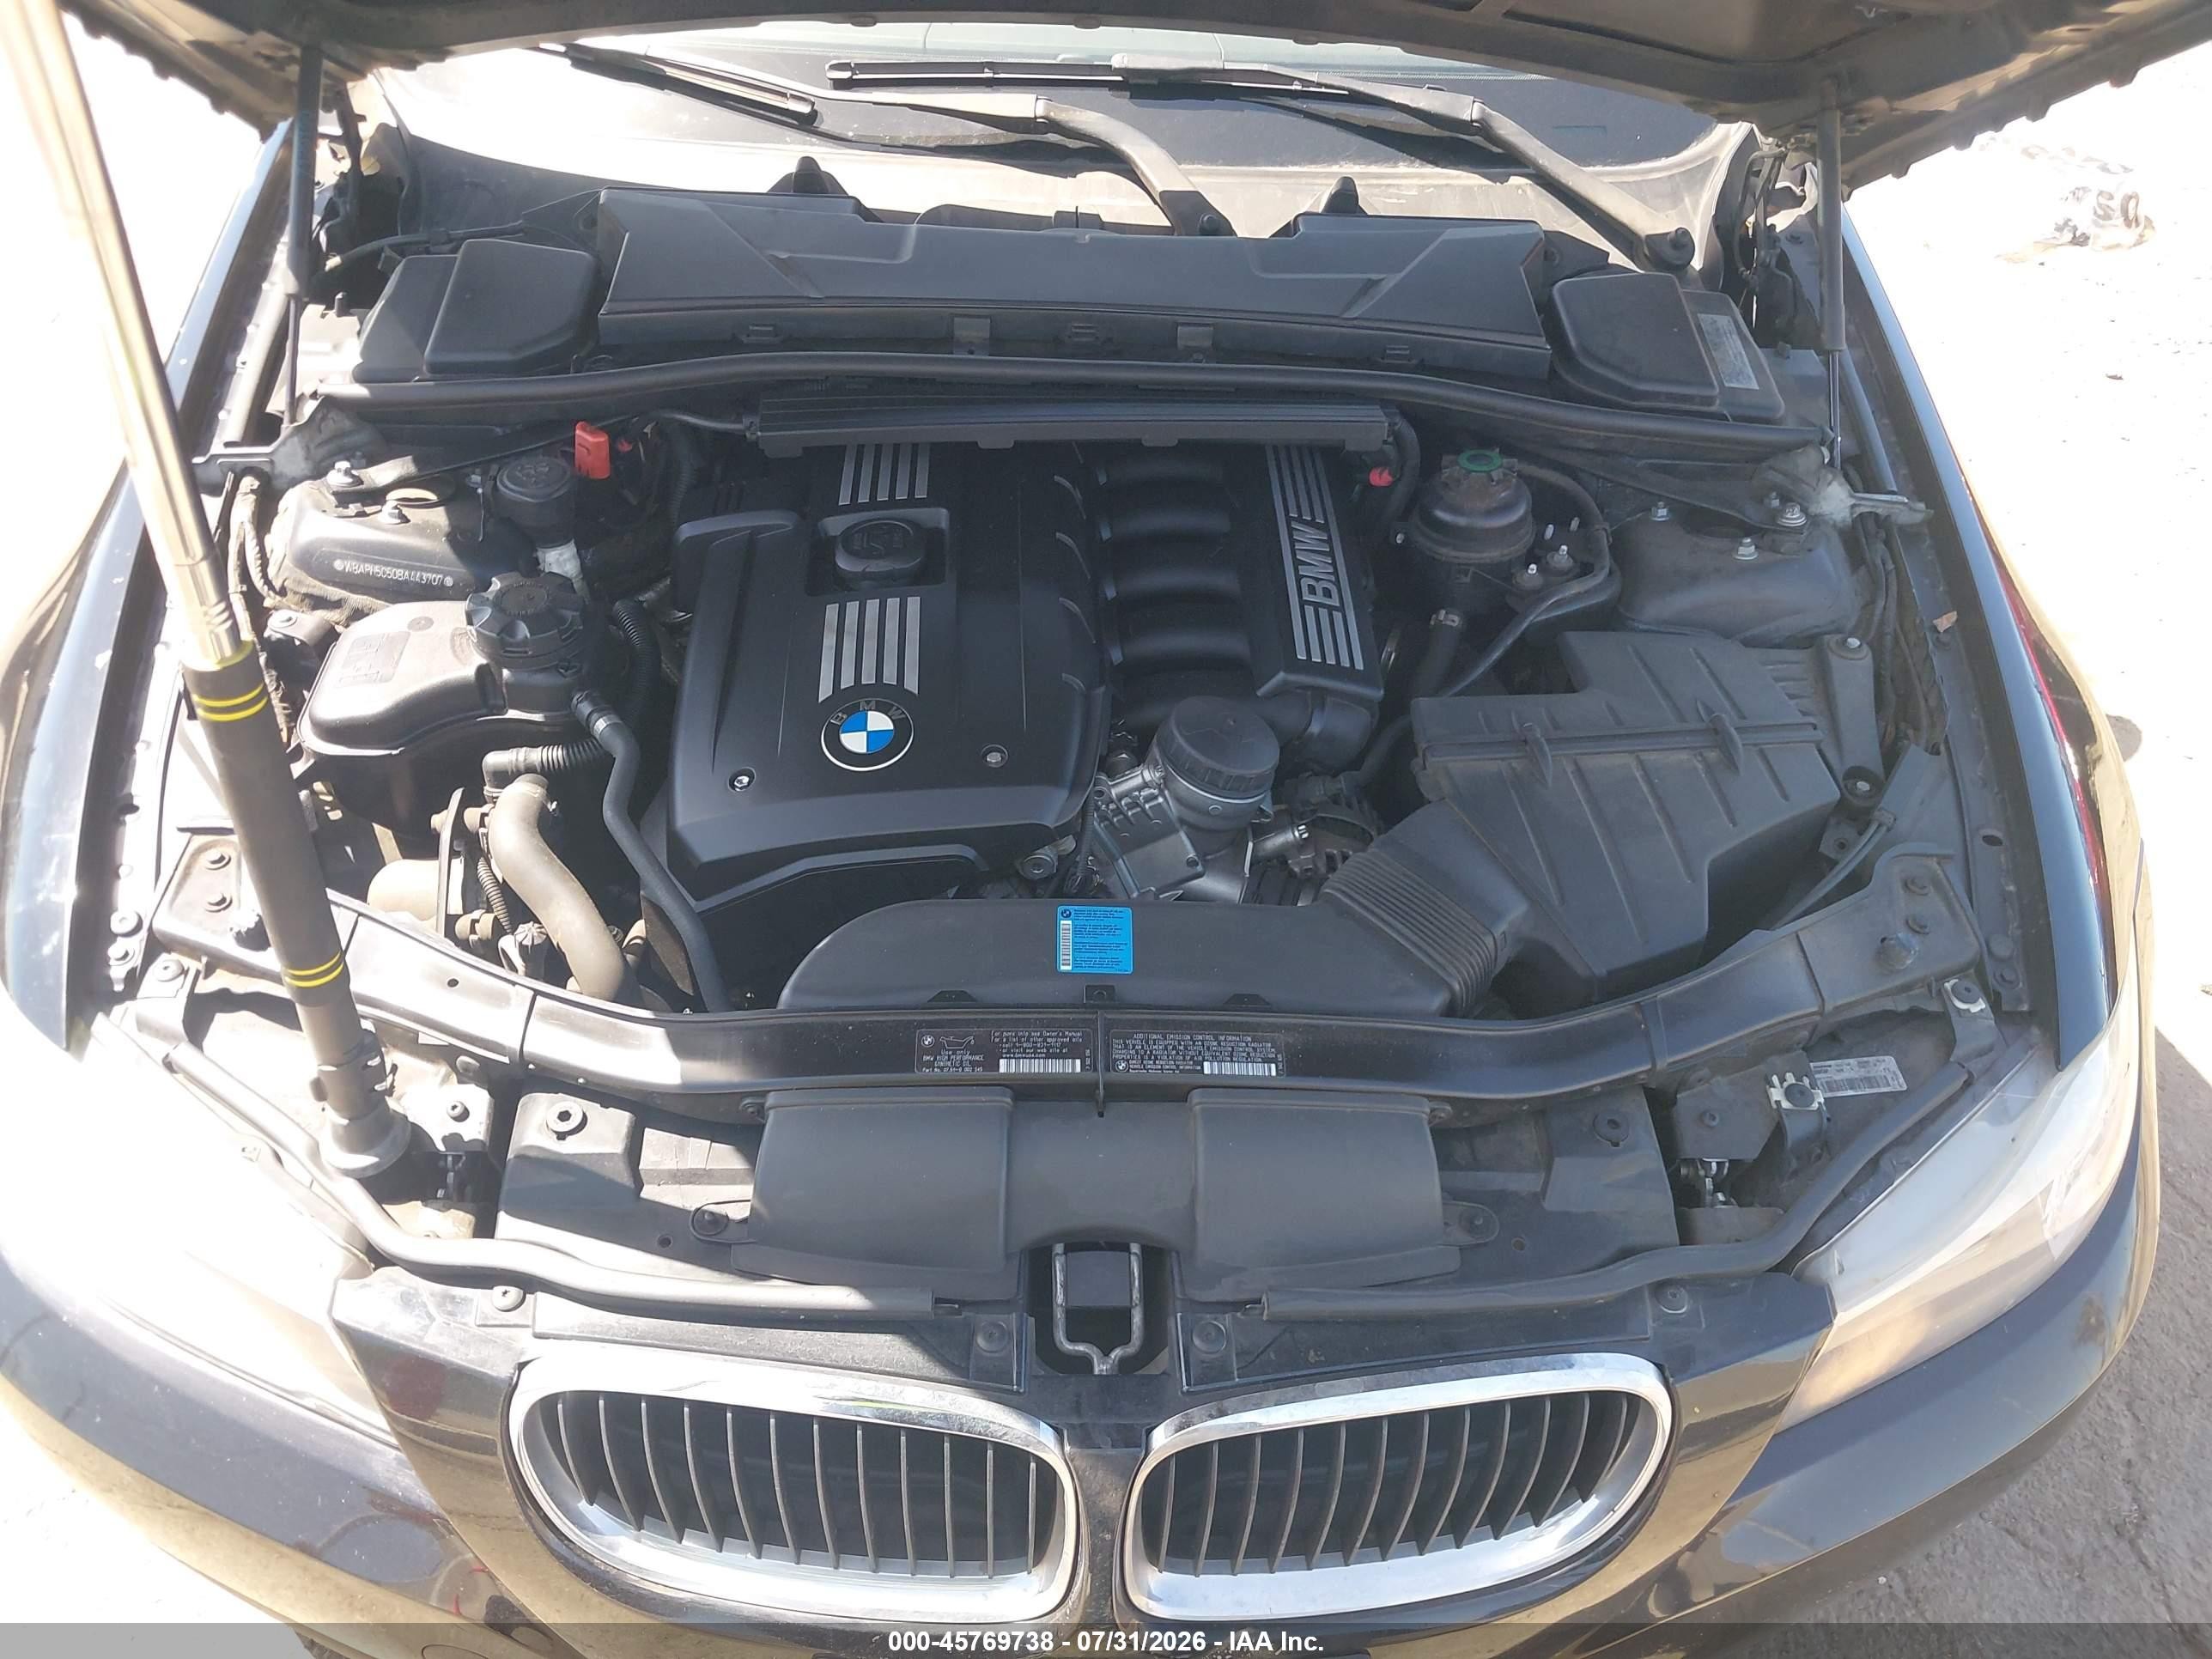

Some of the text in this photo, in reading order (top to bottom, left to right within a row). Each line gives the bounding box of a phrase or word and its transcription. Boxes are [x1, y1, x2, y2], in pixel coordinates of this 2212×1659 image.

[1291, 520, 1340, 607] BMW
[830, 700, 907, 726] BMW
[957, 1048, 971, 1057] only
